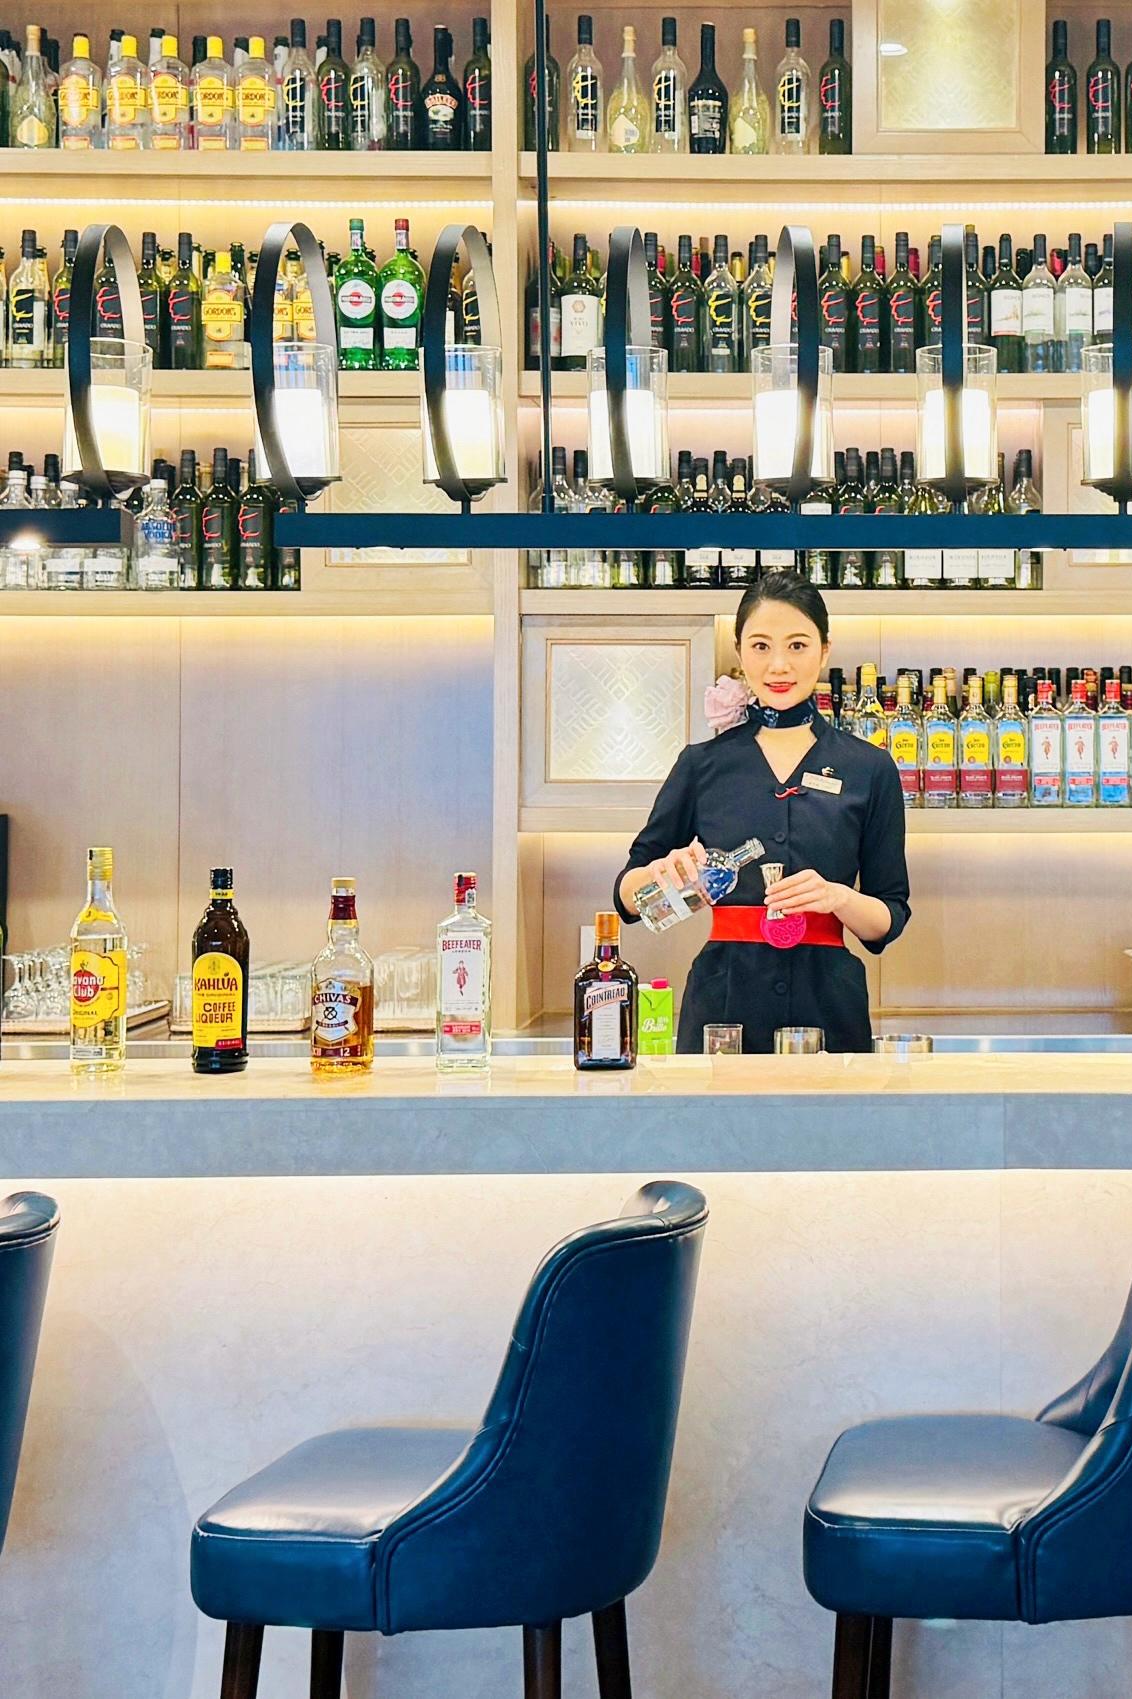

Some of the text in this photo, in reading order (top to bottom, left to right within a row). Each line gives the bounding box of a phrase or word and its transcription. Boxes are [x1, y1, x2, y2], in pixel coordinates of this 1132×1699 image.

[442, 939, 482, 951] BEEFEATER
[314, 993, 351, 1004] CHIVAS
[586, 987, 626, 1010] COINTREAU
[203, 1001, 236, 1012] COFFEE
[195, 1012, 233, 1024] LIQUEUR
